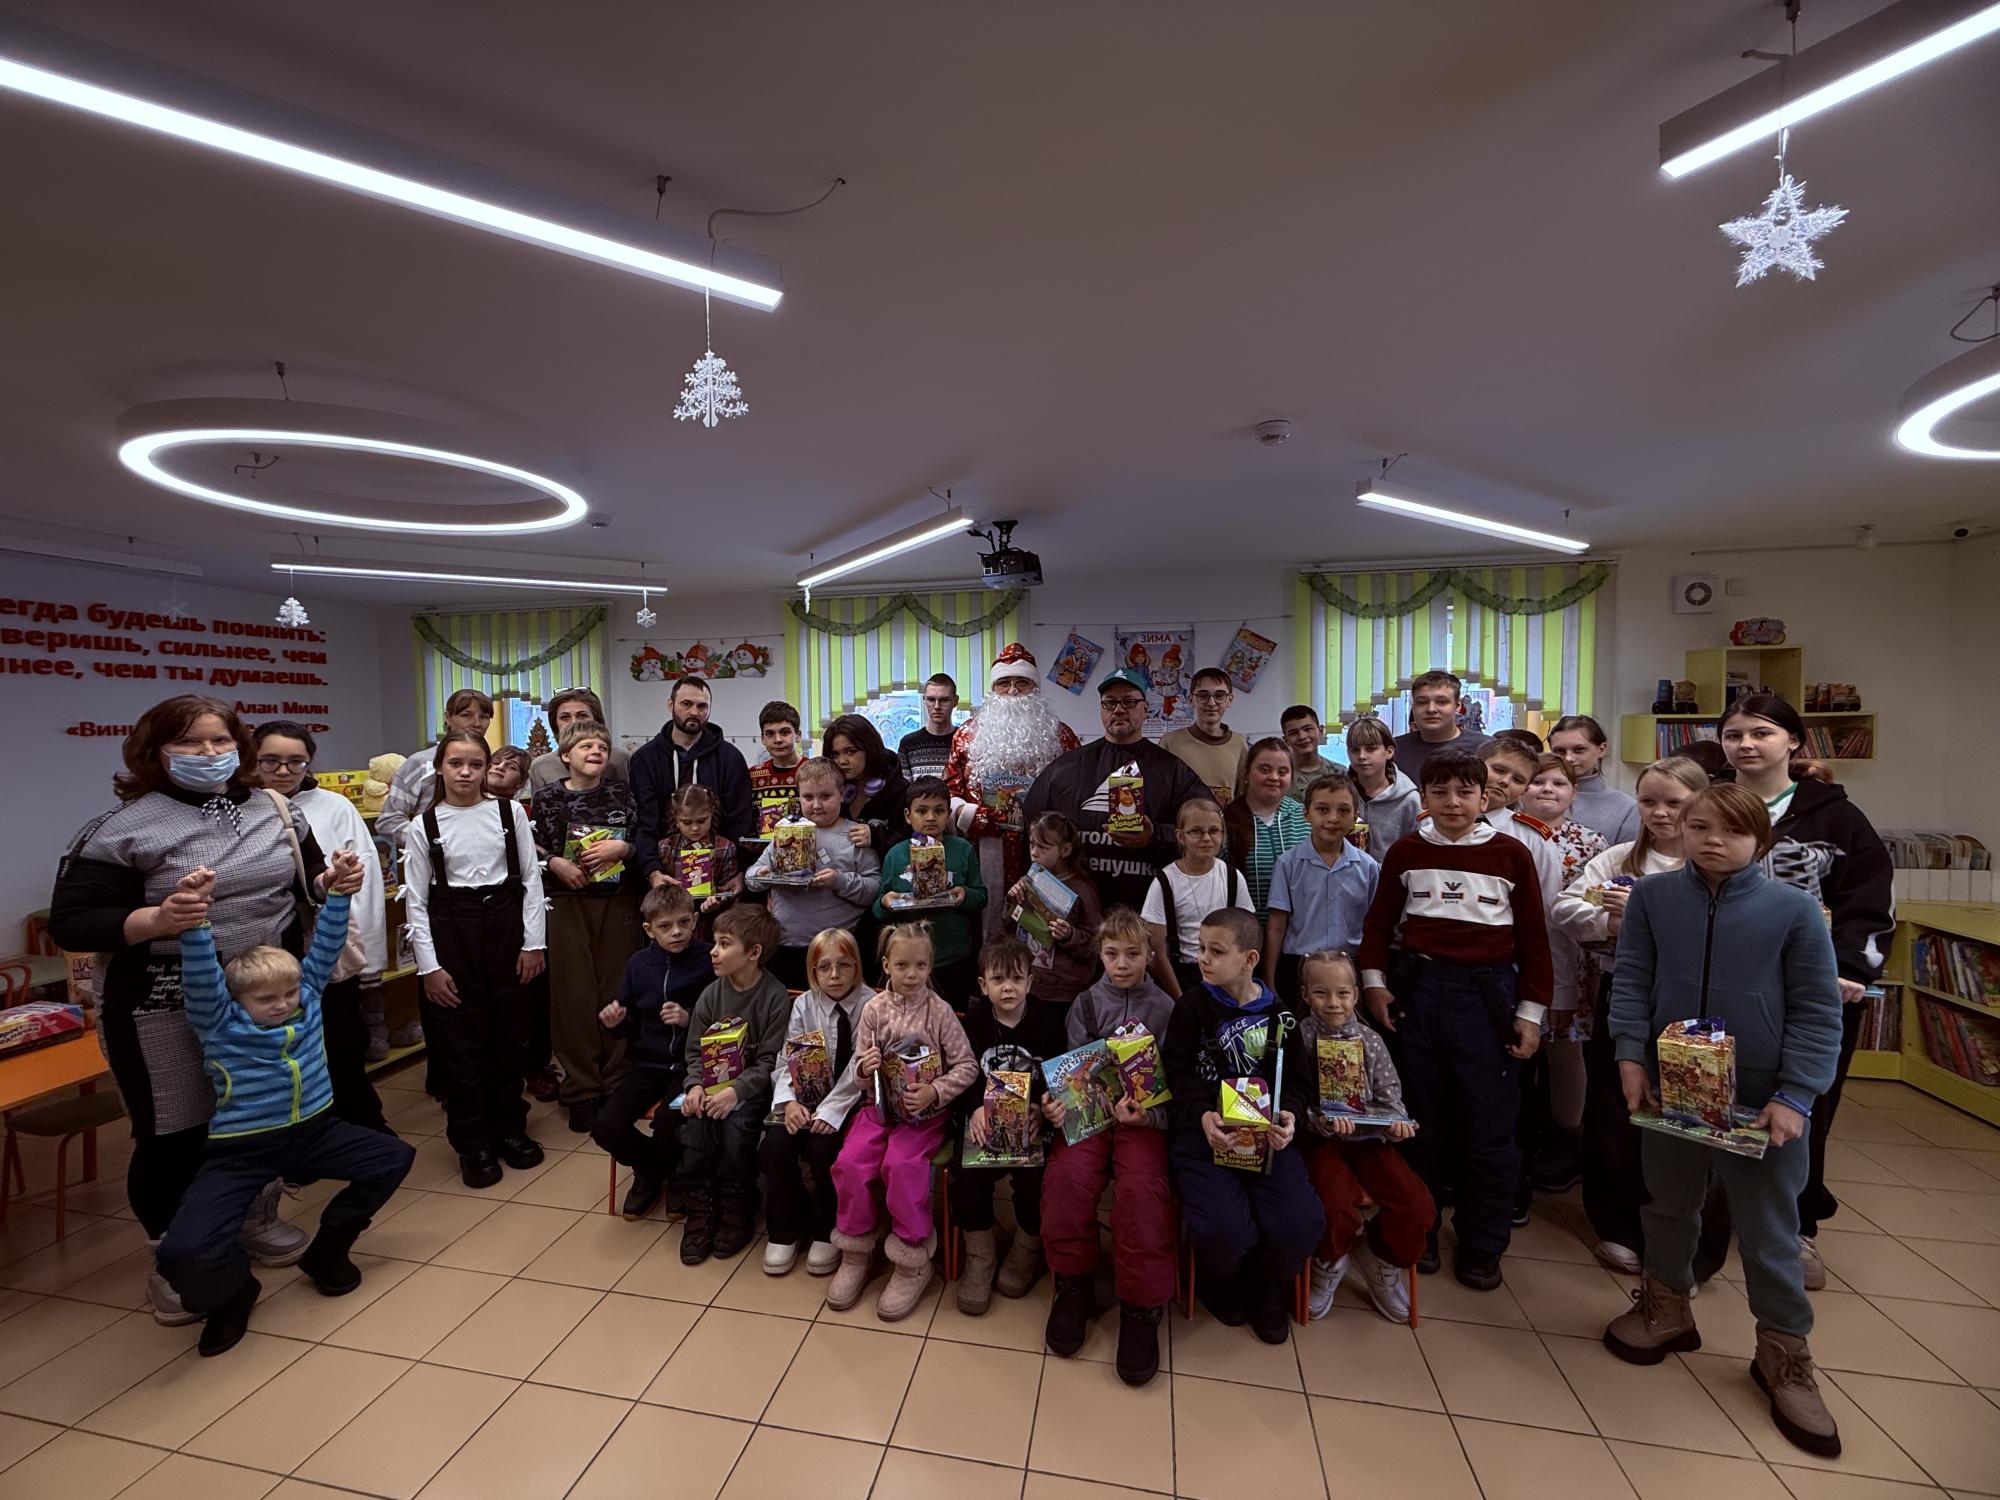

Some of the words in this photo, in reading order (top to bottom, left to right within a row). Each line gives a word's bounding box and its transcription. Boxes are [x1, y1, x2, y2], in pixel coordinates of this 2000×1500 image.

[87, 603, 206, 631] будешь
[213, 620, 327, 642] помнить:
[0, 628, 150, 656] веришь,
[158, 640, 277, 664] сильнее,
[282, 649, 327, 664] чем
[1141, 634, 1172, 644] ЗИМА
[0, 657, 84, 679] нее,
[93, 662, 157, 679] чем
[164, 666, 203, 681] ты
[209, 667, 329, 688] думаешь.
[235, 700, 278, 714] Алан
[282, 701, 329, 714] Милн
